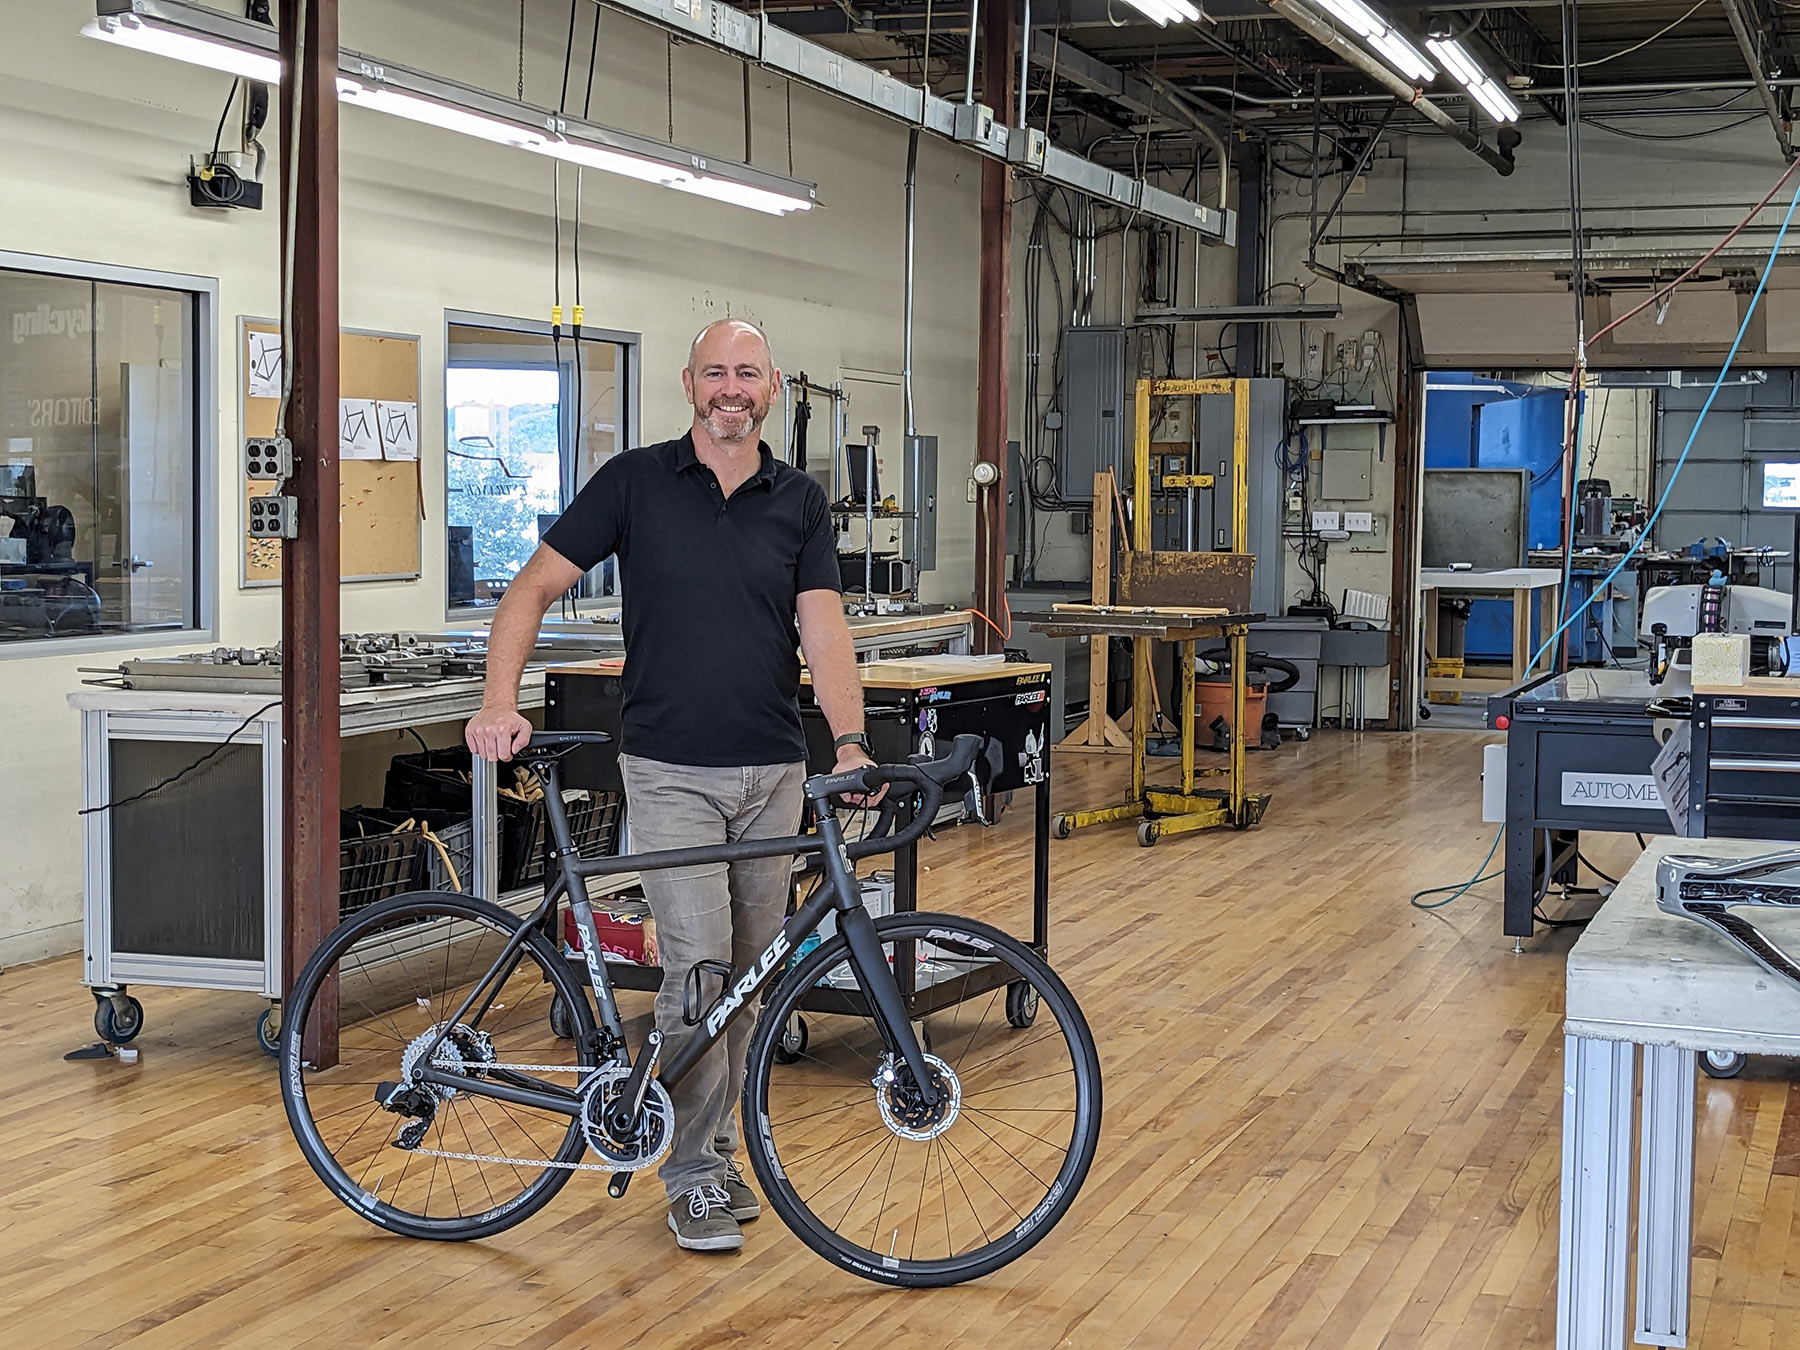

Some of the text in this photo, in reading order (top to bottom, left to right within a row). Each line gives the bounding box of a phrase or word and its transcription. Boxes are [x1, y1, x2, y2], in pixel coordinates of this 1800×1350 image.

[824, 773, 858, 785] PARLEE
[576, 922, 608, 1001] PARLEE
[925, 928, 996, 952] PARLEE
[706, 928, 792, 1038] PARLEE
[290, 1030, 304, 1098] PARLEE
